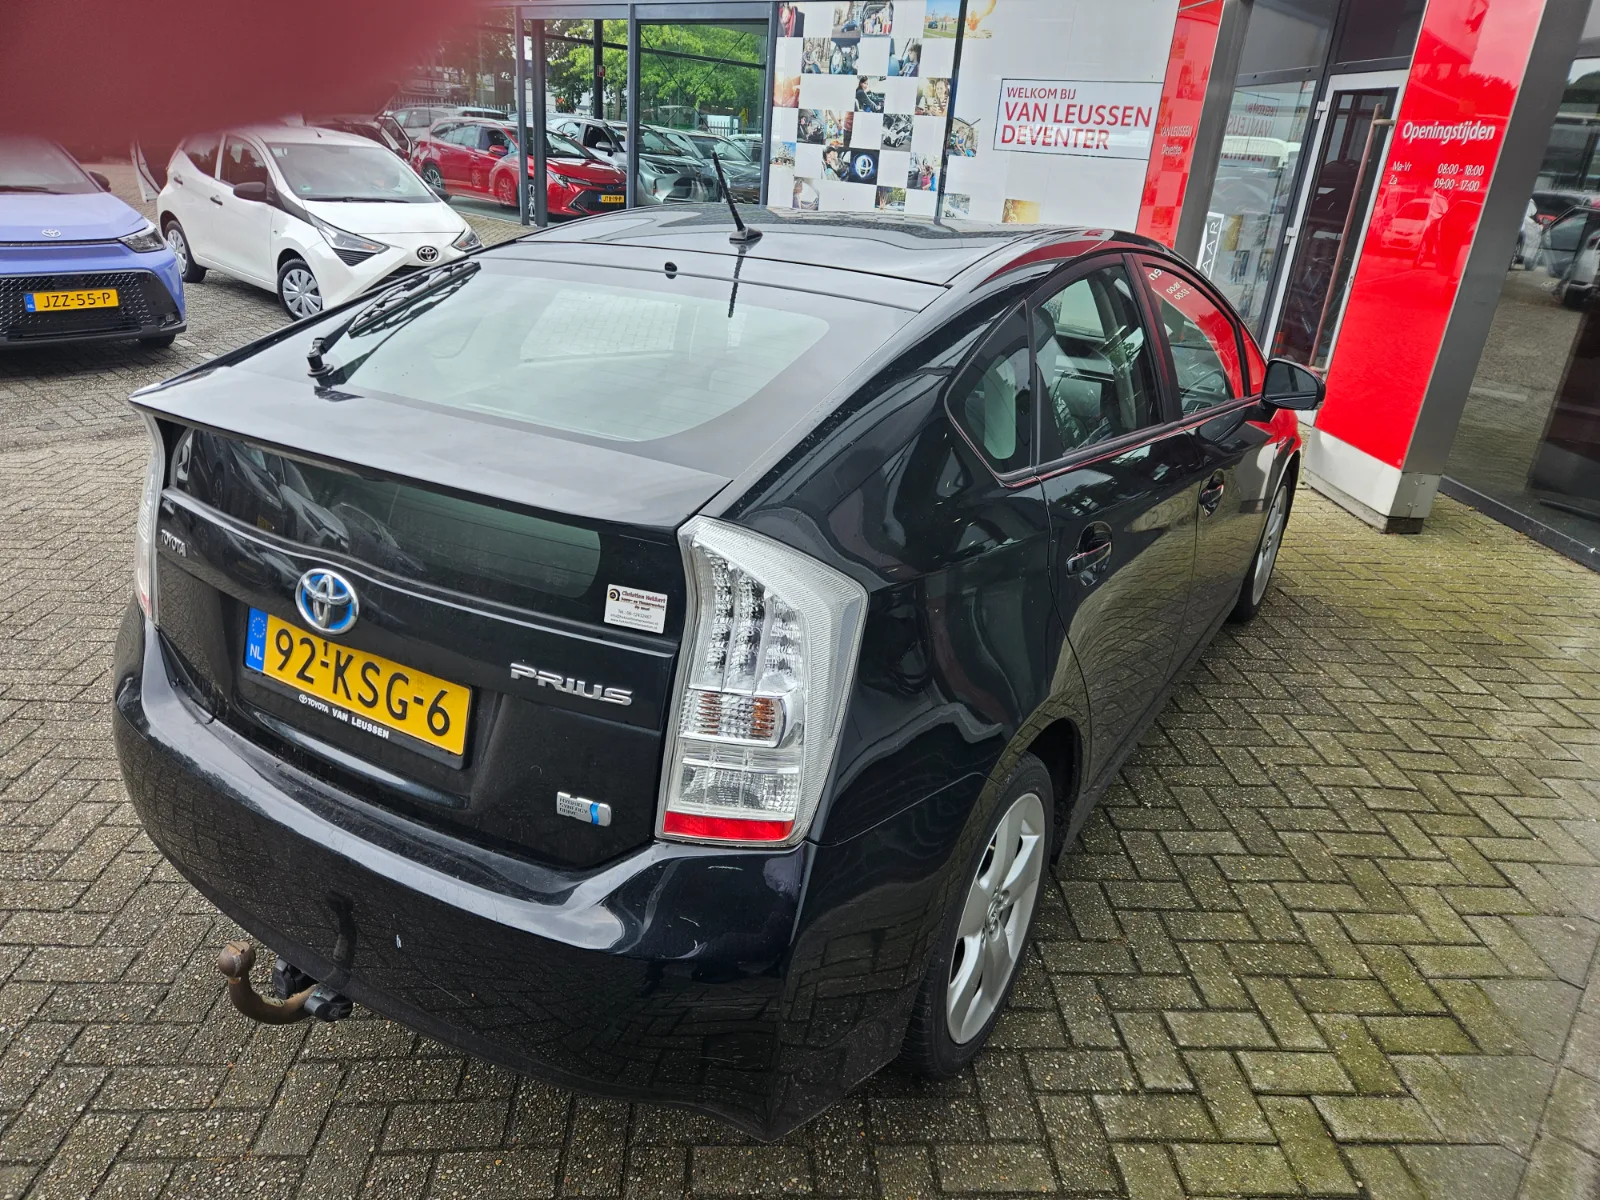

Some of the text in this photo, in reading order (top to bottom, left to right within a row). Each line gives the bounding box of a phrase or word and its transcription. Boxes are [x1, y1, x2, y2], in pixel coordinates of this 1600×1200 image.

[1007, 87, 1076, 100] WELKOM BIJ
[1005, 101, 1152, 128] VAN LEUSSEN
[1001, 124, 1110, 150] DEVENTER
[1402, 120, 1496, 146] Openingstijden
[1392, 160, 1412, 172] Ma-Vr
[1437, 163, 1459, 175] 08:00
[1465, 164, 1485, 176] 18:00
[1388, 174, 1398, 185] Za
[1433, 178, 1455, 190] 09:00
[1460, 180, 1480, 192] 17:00
[43, 292, 111, 309] JZZ-55-P
[161, 528, 187, 557] TOYOTA
[250, 643, 262, 660] NL
[275, 628, 451, 736] 92-KSG-6
[510, 663, 633, 706] PRIUS
[307, 698, 390, 739] TOYOTA VAN LEUSSEN
